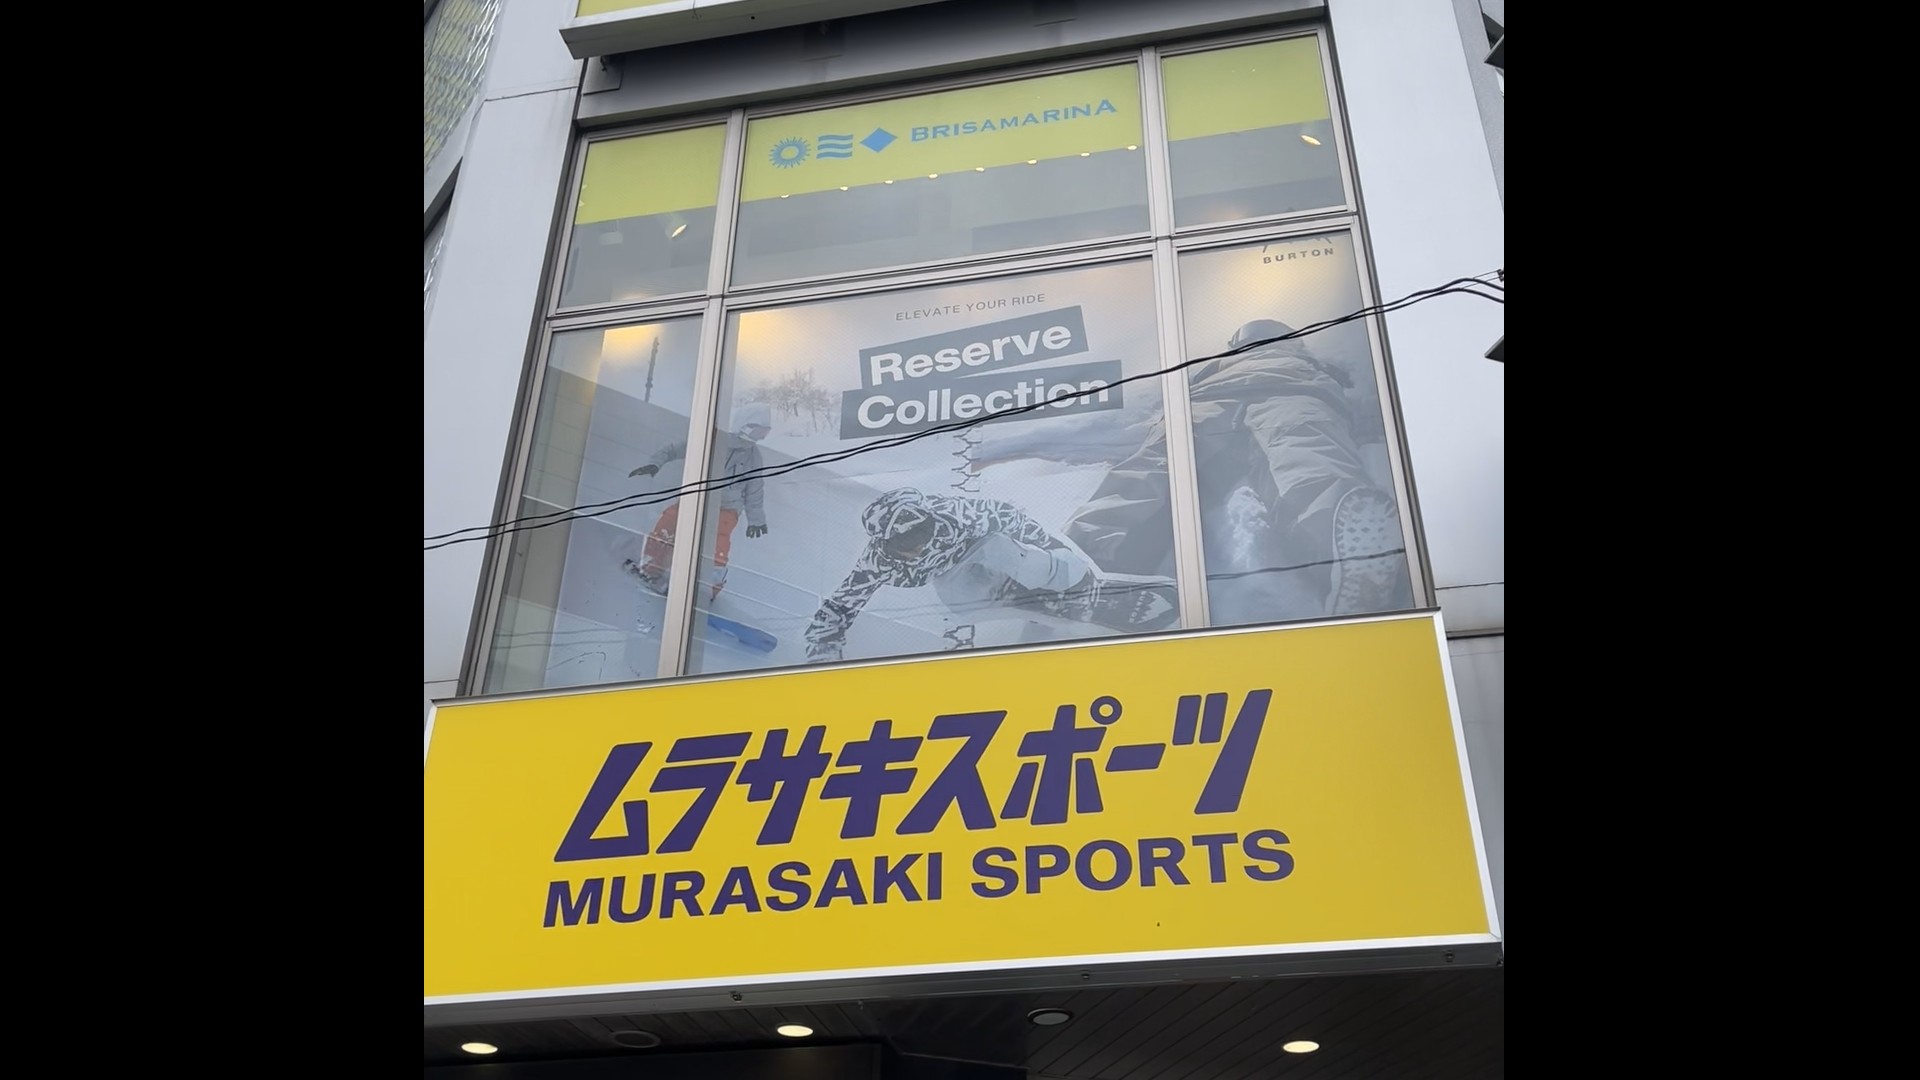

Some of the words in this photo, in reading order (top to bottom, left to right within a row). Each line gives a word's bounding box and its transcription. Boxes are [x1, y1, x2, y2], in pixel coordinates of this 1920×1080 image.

[911, 99, 1117, 142] BRISAMARINA
[1263, 247, 1334, 264] BURTON
[895, 305, 960, 321] ELEVATE
[966, 299, 1006, 312] YOUR
[1011, 293, 1045, 307] RIDE
[871, 325, 1072, 386] Reserve
[858, 377, 1109, 429] Collection
[554, 689, 1273, 862] ムラサキスポーツ
[543, 852, 943, 928] MURASAKI
[971, 829, 1295, 898] SPORTS
